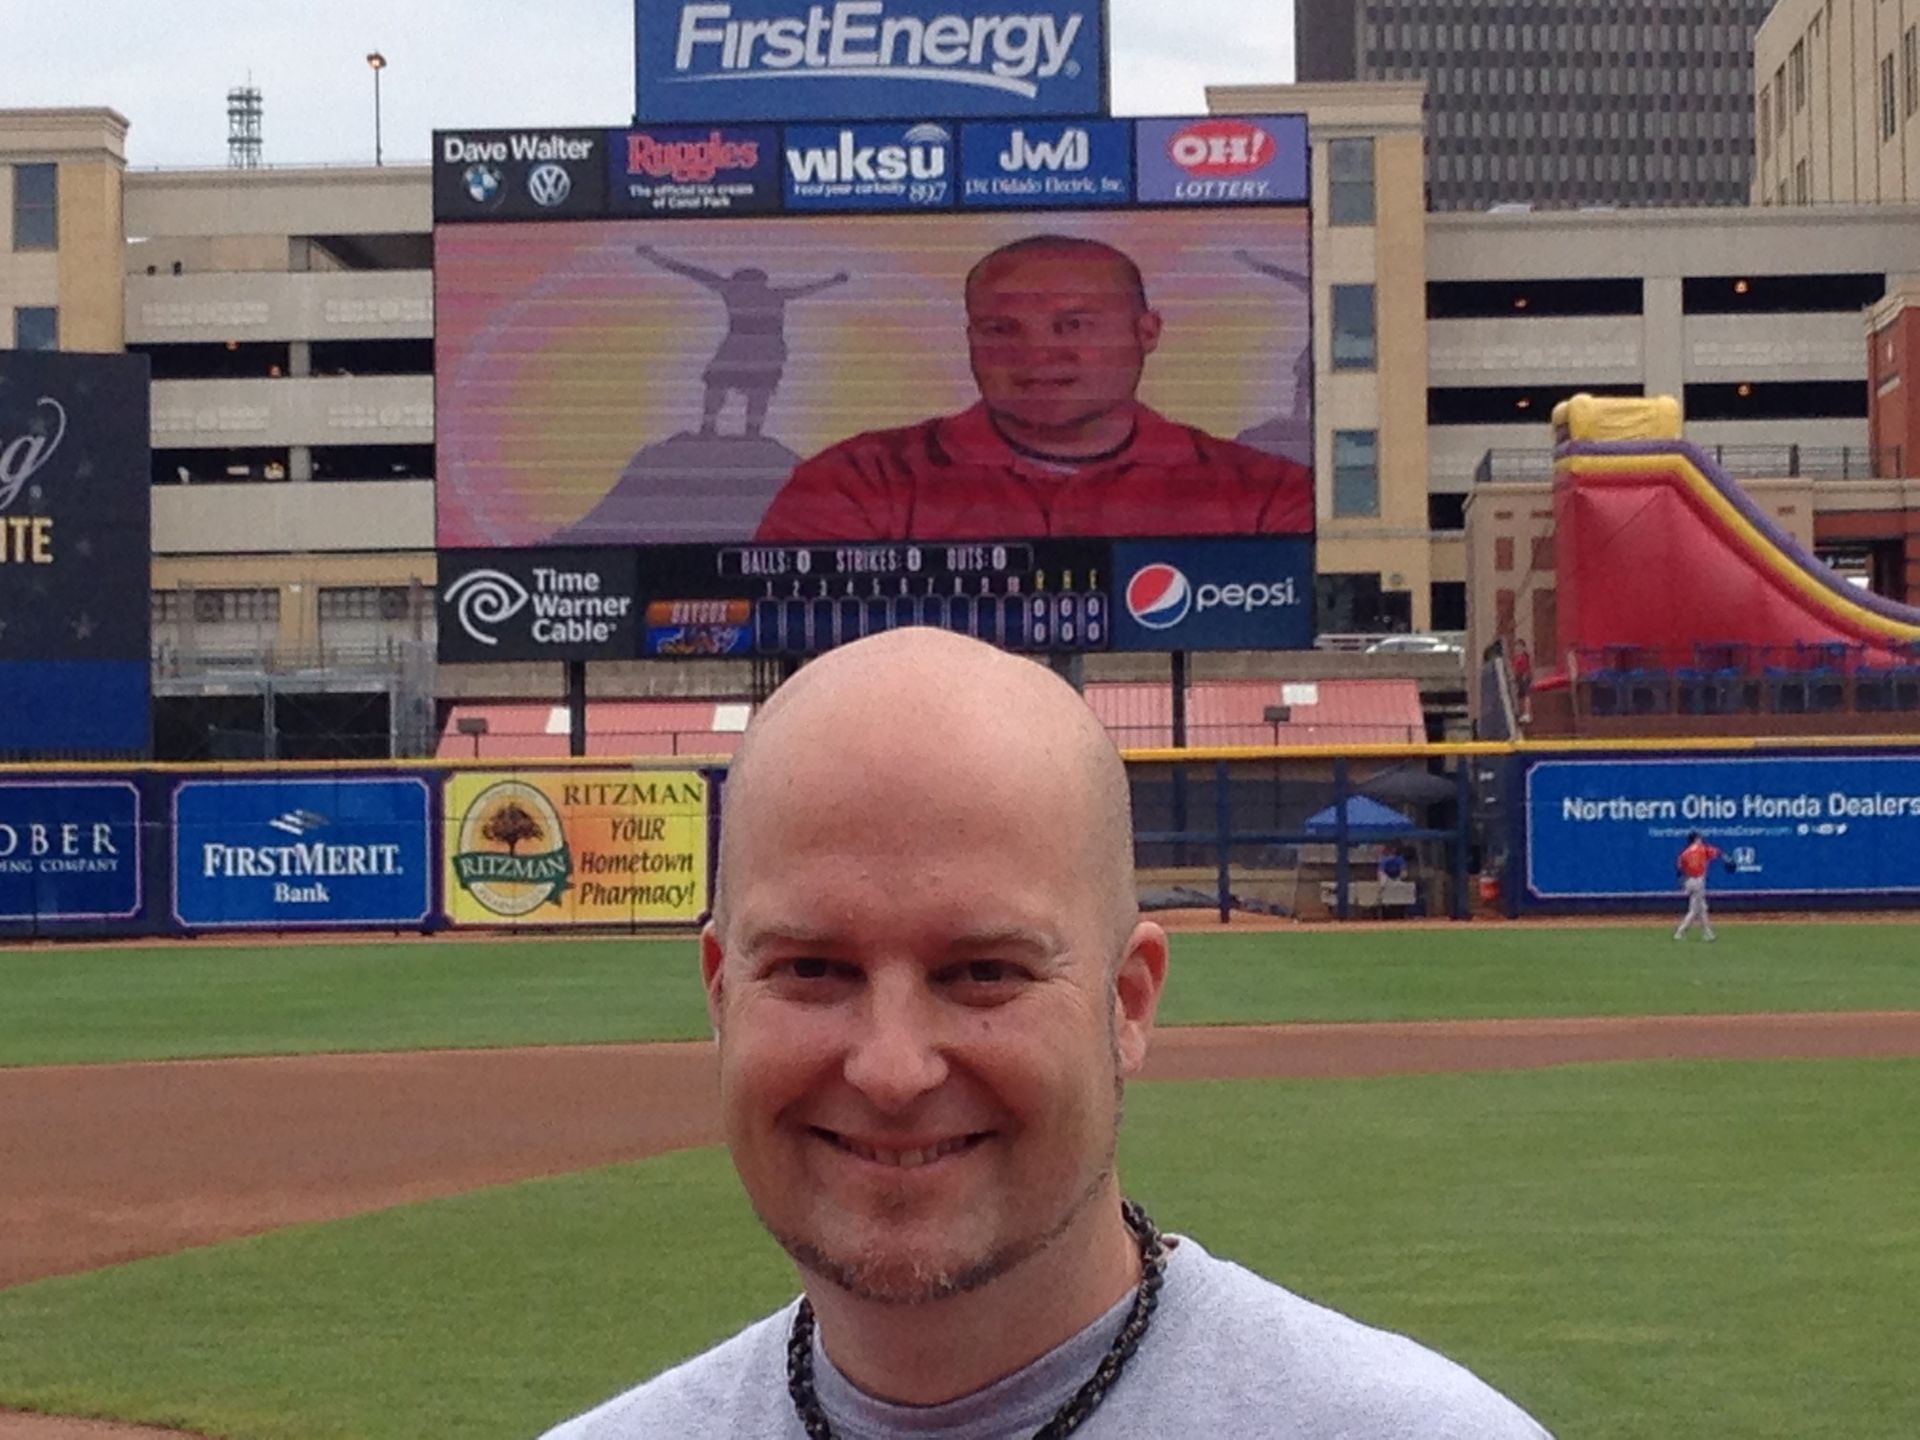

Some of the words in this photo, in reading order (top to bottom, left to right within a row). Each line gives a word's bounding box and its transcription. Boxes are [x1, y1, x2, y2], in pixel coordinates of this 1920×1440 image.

[675, 1, 1084, 79] FirstEnergy
[444, 137, 506, 161] Dave
[510, 135, 592, 159] Walter
[627, 131, 758, 181] Ruggles
[785, 131, 945, 180] wksu
[1171, 129, 1267, 167] OH!
[629, 184, 651, 197] The
[654, 183, 694, 196] official
[697, 184, 713, 195] ice
[717, 183, 753, 195] cream
[1174, 181, 1266, 198] LOTTERY
[652, 196, 666, 208] of
[669, 196, 701, 208] Canal
[703, 195, 730, 207] Park
[797, 550, 811, 574] 0
[907, 547, 921, 571] 0
[992, 546, 1007, 570] 0
[532, 568, 600, 592] Time
[792, 579, 800, 596] 2
[819, 579, 827, 596] 3
[846, 579, 854, 595] 4
[927, 577, 934, 594] 7
[532, 594, 632, 617] Warner
[1197, 577, 1294, 612] pepsi
[1034, 599, 1045, 617] 0
[1061, 598, 1072, 616] 0
[1088, 597, 1099, 616] 0
[531, 618, 610, 643] Cable
[1034, 623, 1045, 642] 0
[1062, 622, 1073, 641] 0
[1088, 622, 1099, 641] 0
[562, 783, 703, 806] RITZMAN
[1562, 796, 1676, 821] Northern
[1681, 794, 1737, 820] Ohio
[1743, 794, 1820, 818] Honda
[1828, 792, 1920, 817] Dealers
[610, 818, 665, 841] YOUR
[40, 858, 118, 872] COMPANY
[459, 855, 566, 878] RITZMAN
[580, 851, 693, 874] Hometown
[274, 883, 330, 903] Bank
[580, 881, 695, 909] Pharmacy!
